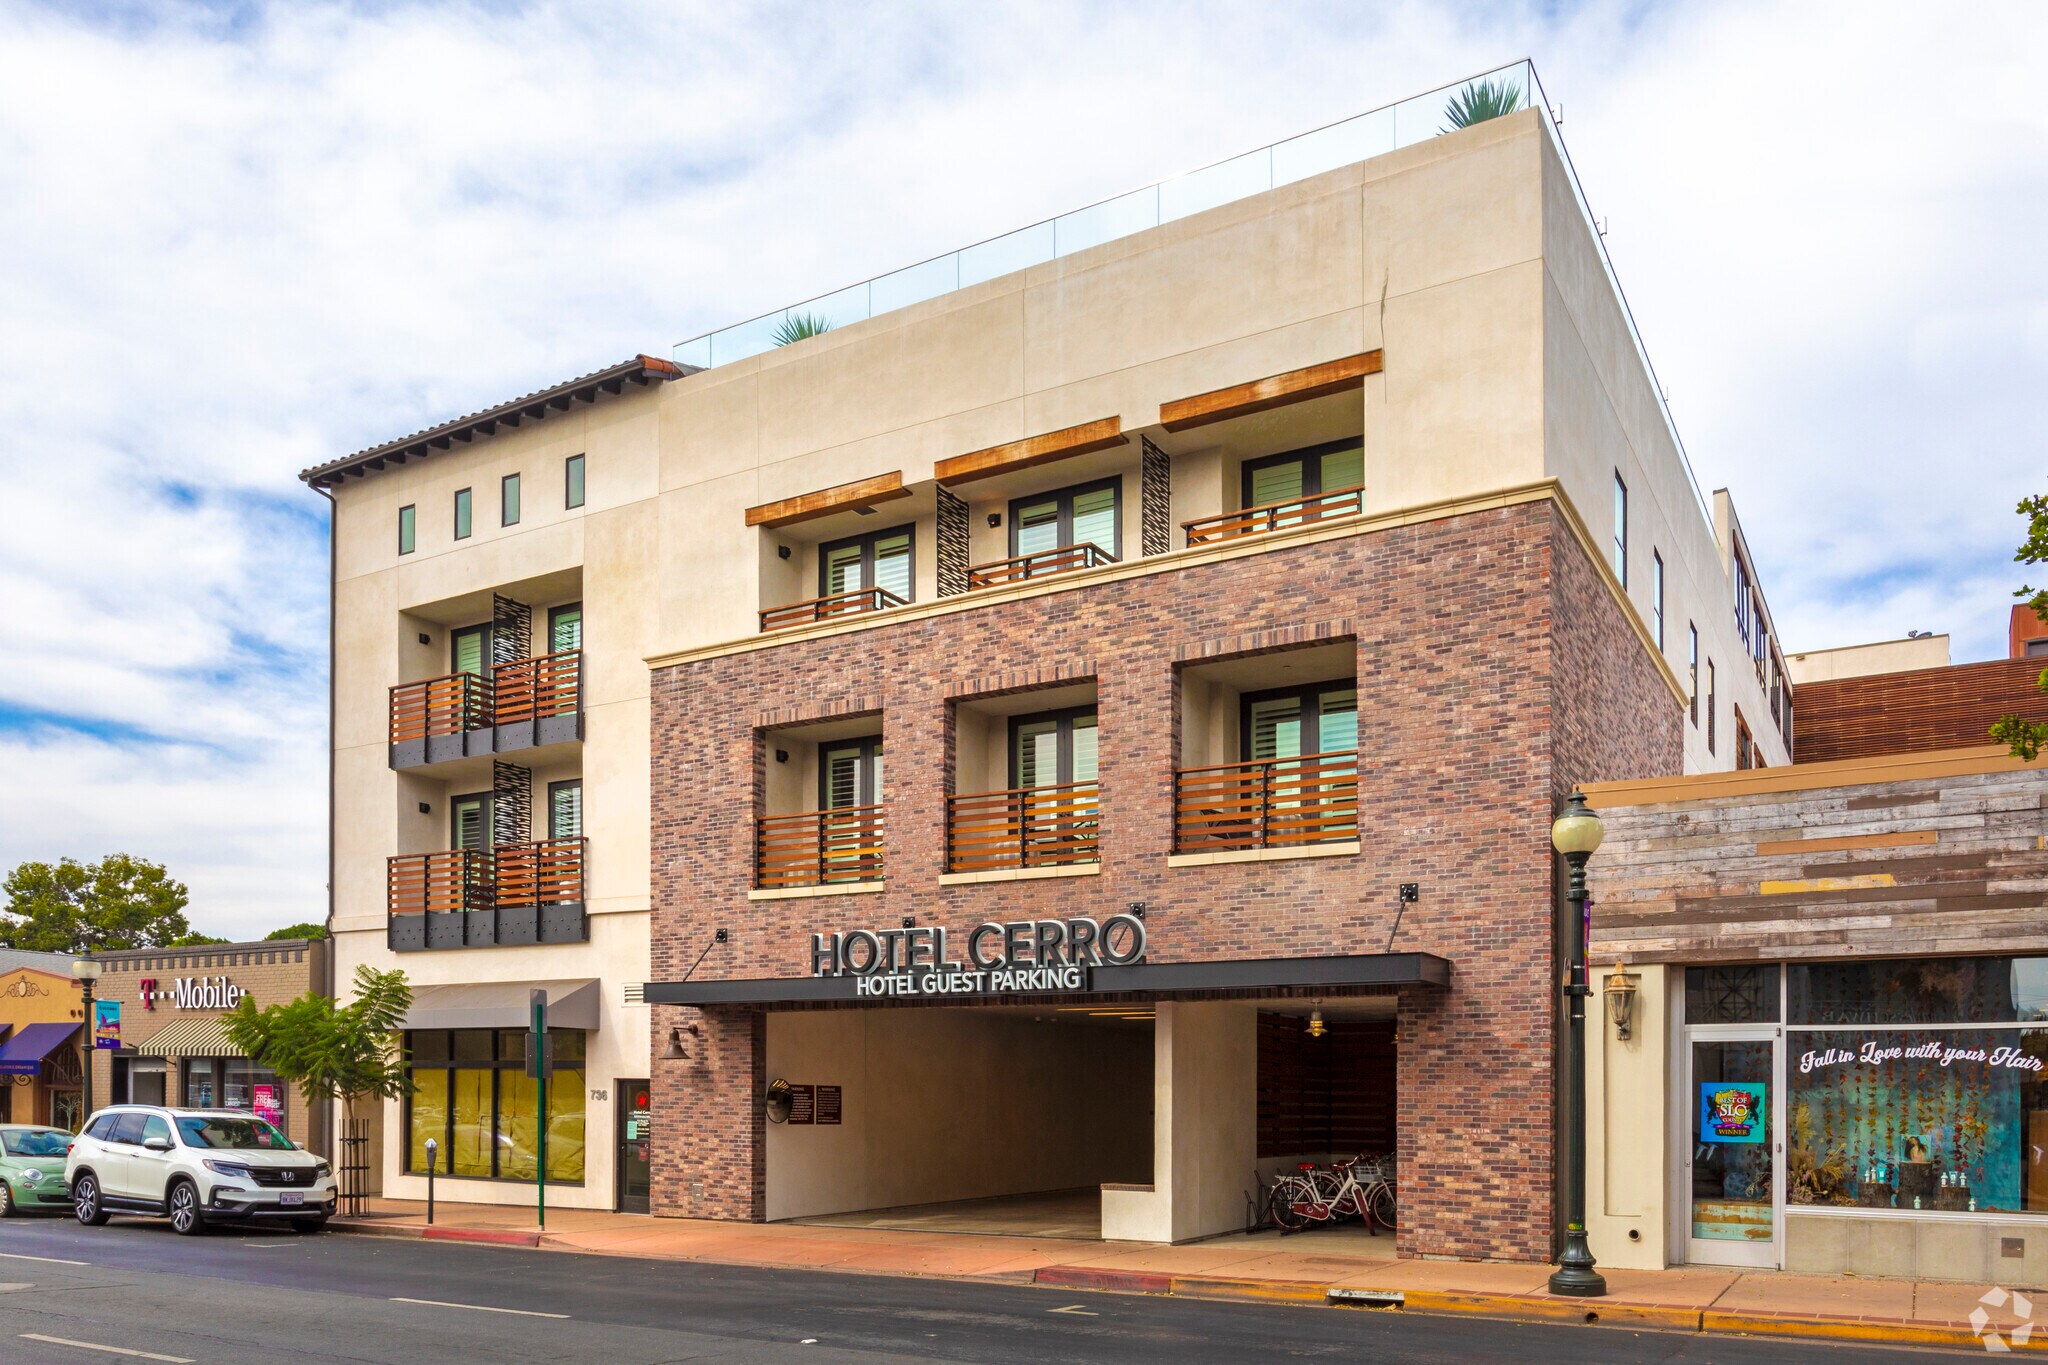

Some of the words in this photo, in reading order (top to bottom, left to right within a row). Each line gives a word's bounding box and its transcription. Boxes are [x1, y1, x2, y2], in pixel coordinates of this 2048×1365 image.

[811, 926, 961, 977] HOTEL
[968, 914, 1146, 970] CERRO
[857, 974, 918, 996] HOTEL
[922, 971, 987, 994] GUEST
[991, 967, 1081, 991] PARKING
[1800, 1049, 1836, 1073] Fall
[1838, 1050, 1855, 1062] in
[1860, 1041, 1902, 1065] Love
[1905, 1041, 1942, 1059] with
[1940, 1047, 1987, 1067] your
[1989, 1046, 2044, 1072] Hair
[1719, 1104, 1748, 1117] SLO
